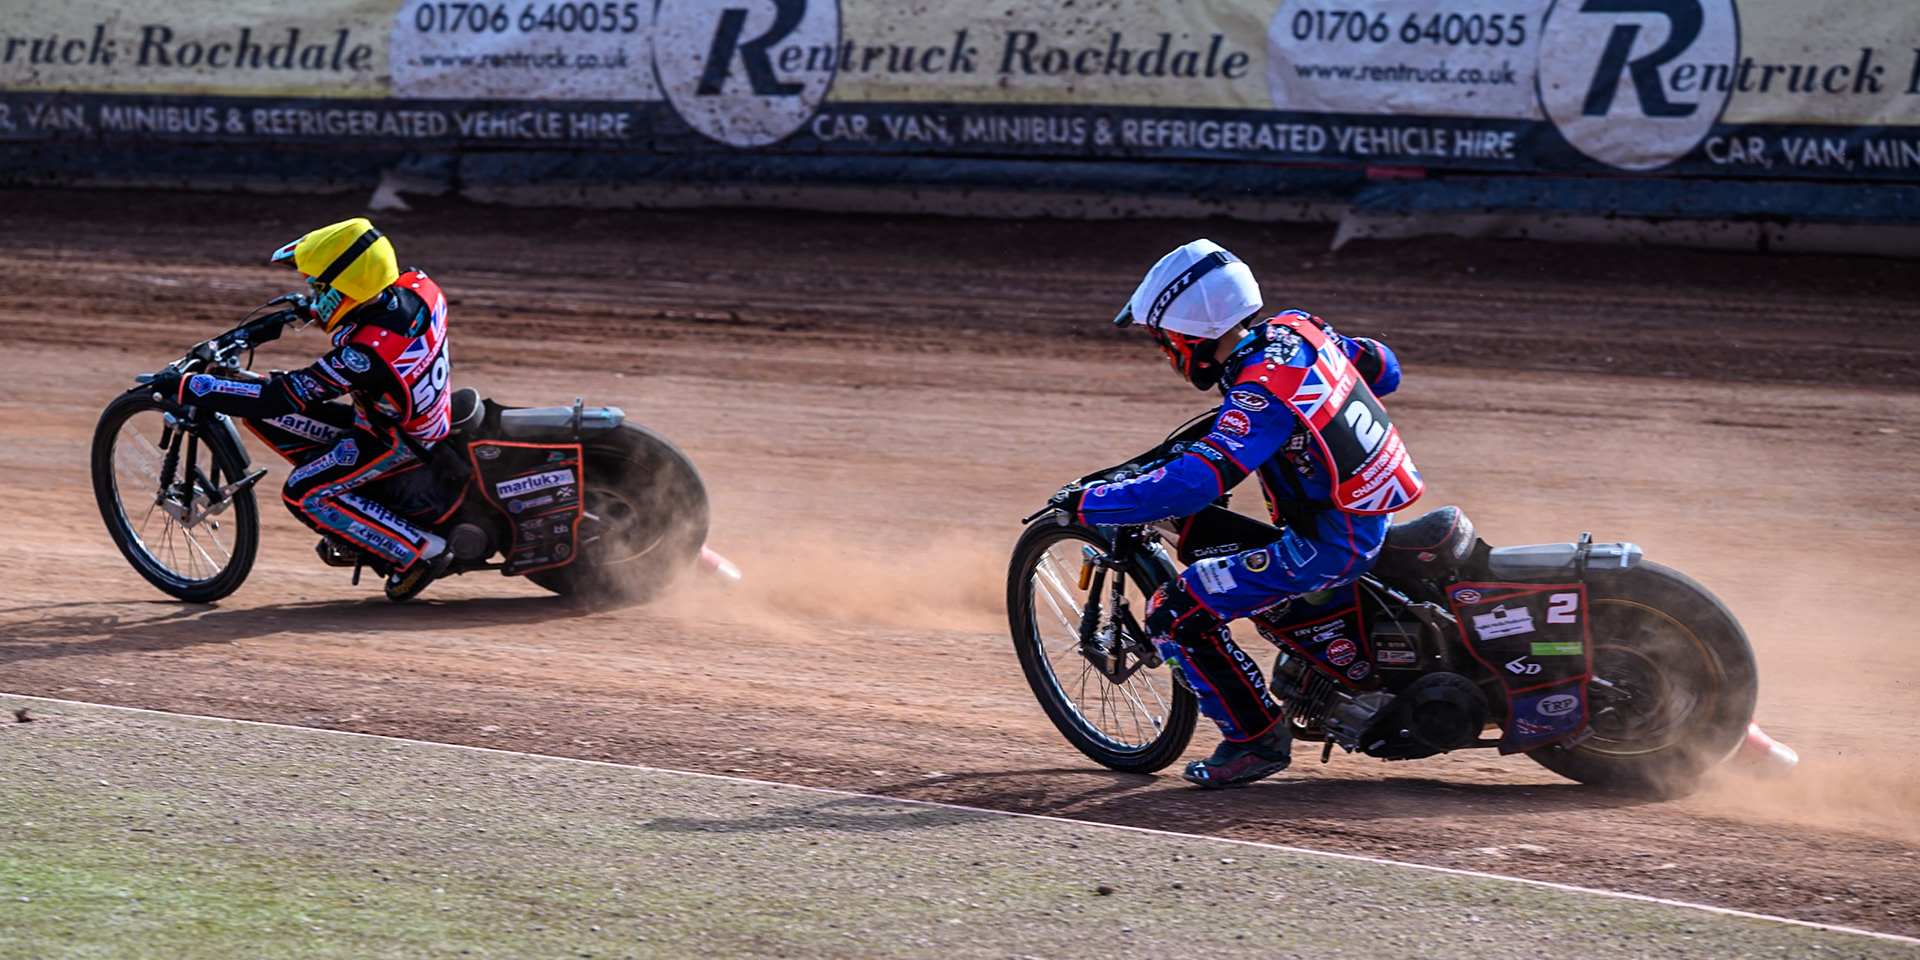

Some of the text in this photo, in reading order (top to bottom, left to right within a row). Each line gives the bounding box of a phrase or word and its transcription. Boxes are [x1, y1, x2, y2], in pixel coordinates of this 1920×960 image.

[415, 2, 638, 33] 01706 640055
[1292, 9, 1526, 46] 01706 640055
[136, 24, 373, 72] Rochdale
[997, 29, 1250, 79] Rochdale
[1295, 60, 1516, 85] www.rentruck.co.uk
[101, 105, 218, 133] MINIBUS
[225, 108, 245, 133] &
[252, 108, 448, 137] REFRIGERATED
[454, 112, 563, 139] VEHICLE
[570, 112, 631, 139] HIRE
[962, 115, 1086, 144] MINIBUS
[1093, 116, 1114, 144] &
[1122, 119, 1326, 151] REFRIGERATED
[1332, 126, 1448, 156] VEHICLE
[1454, 130, 1516, 159] HIRE
[1344, 400, 1385, 454] 2
[1546, 593, 1578, 623] 2
